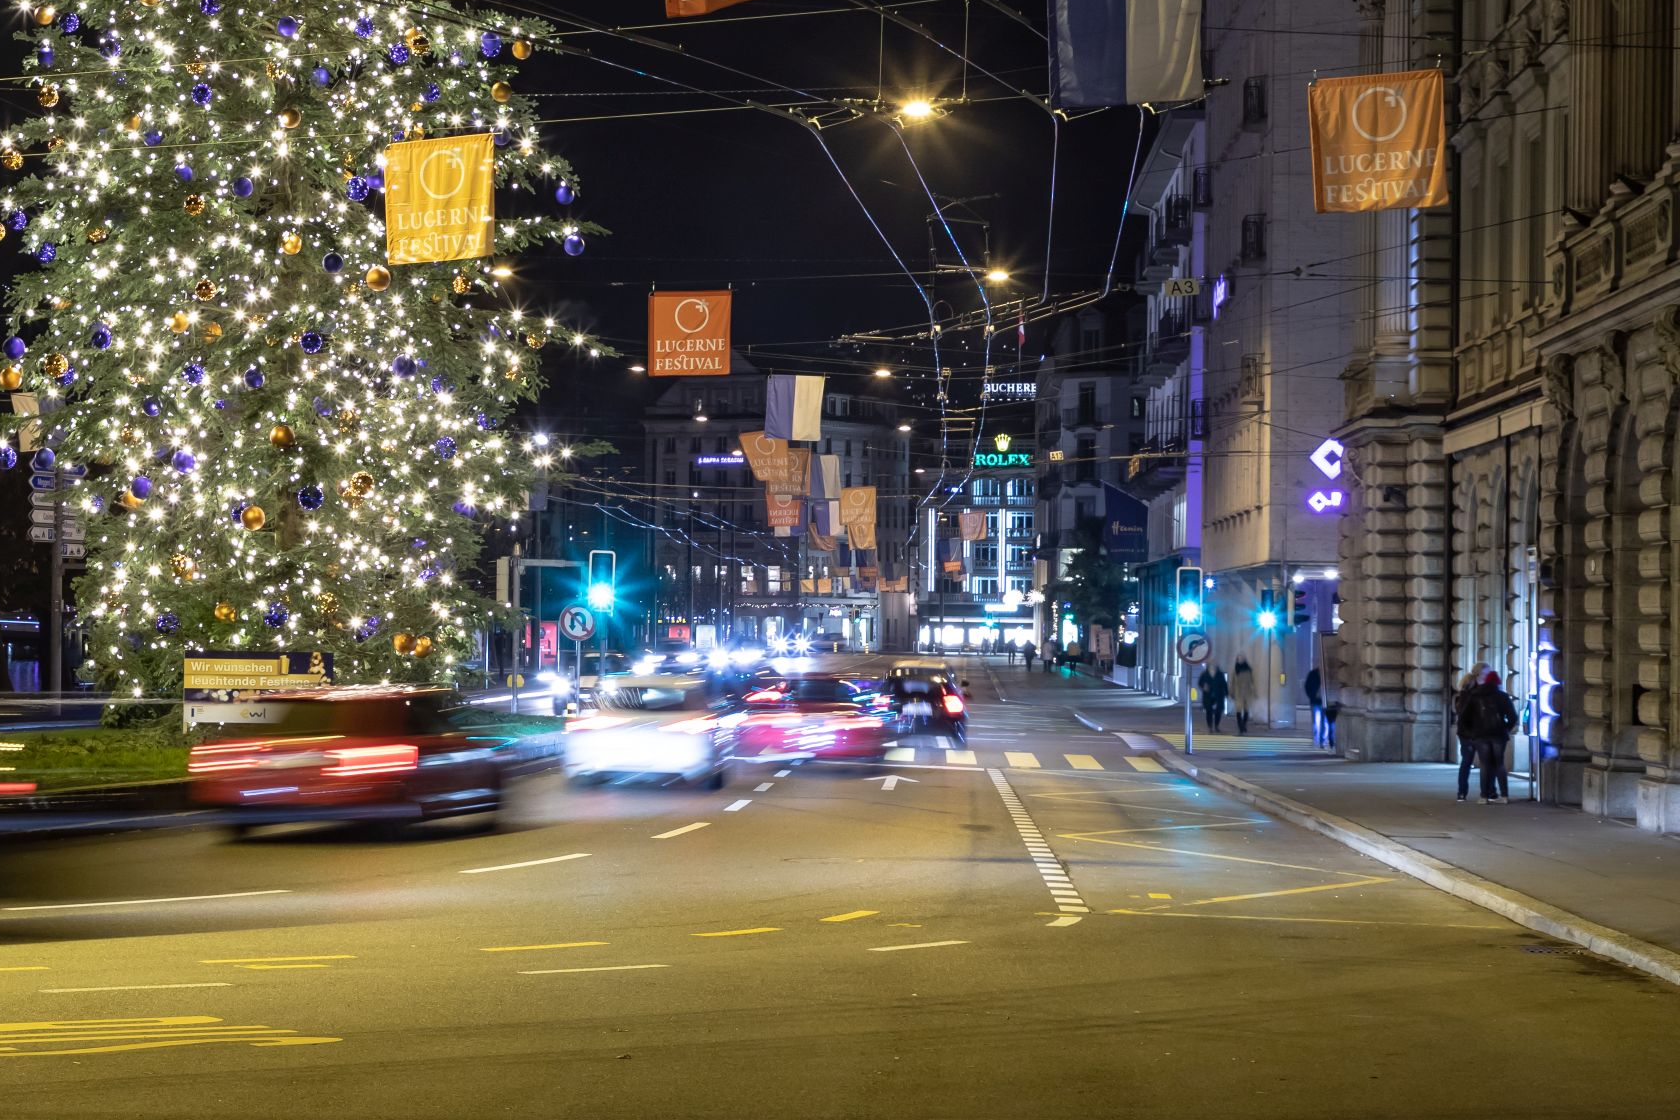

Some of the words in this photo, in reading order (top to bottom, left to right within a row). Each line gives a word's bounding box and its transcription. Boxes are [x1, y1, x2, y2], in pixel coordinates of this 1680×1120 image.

[1324, 147, 1437, 176] LUCERNE
[1324, 177, 1433, 204] FESTIVAL
[397, 204, 489, 230] LUCERNE
[398, 231, 486, 256] FESTIVAL
[1171, 280, 1195, 295] A3
[655, 338, 726, 353] LUCERNE
[655, 354, 723, 371] FESTIVAL
[975, 453, 1031, 467] ROLEX
[191, 661, 211, 672] Wir
[214, 661, 273, 673] wünschen
[191, 676, 256, 687] leuchtende
[240, 708, 267, 720] ewl
